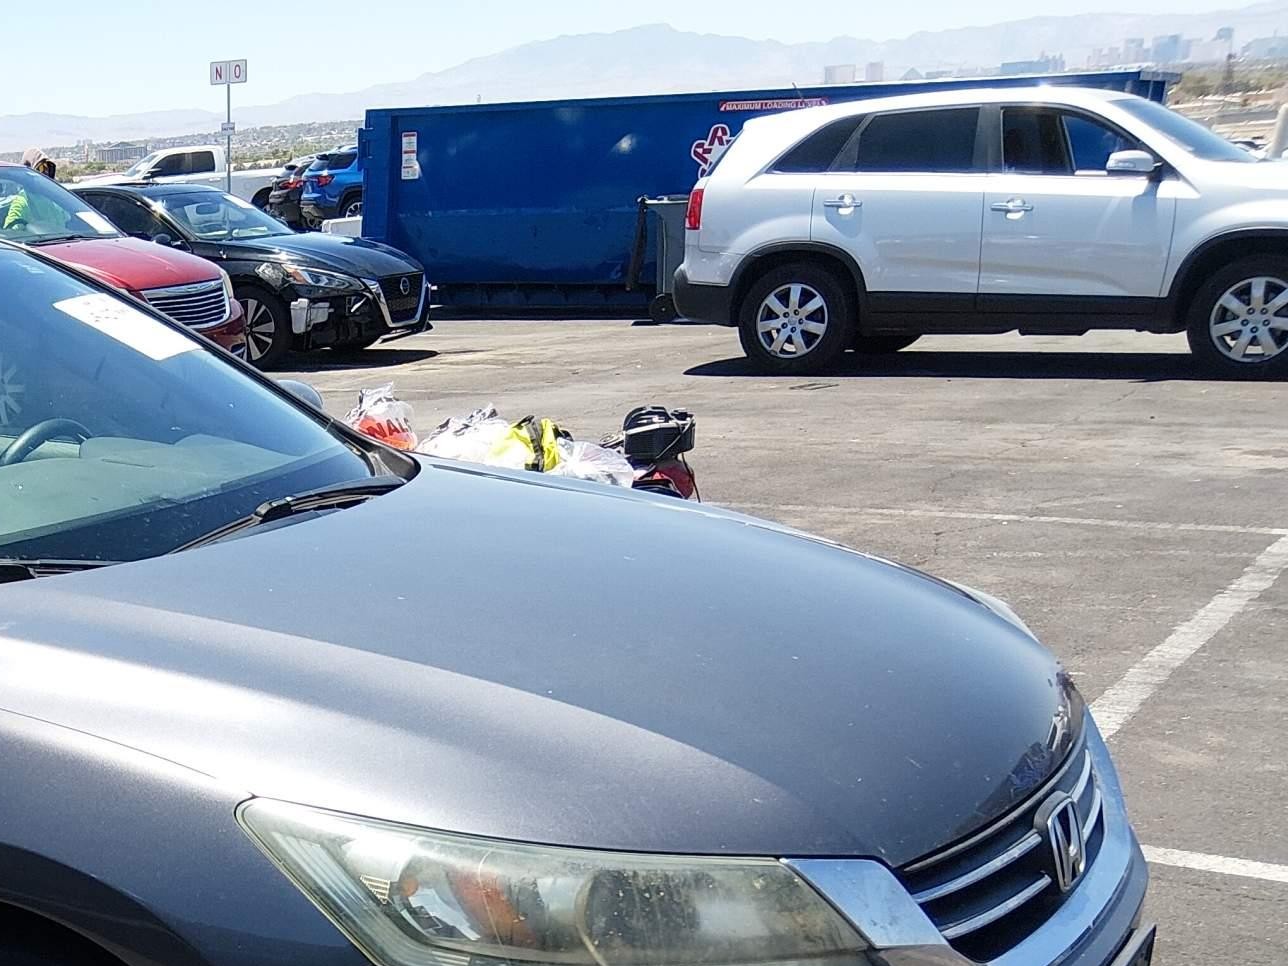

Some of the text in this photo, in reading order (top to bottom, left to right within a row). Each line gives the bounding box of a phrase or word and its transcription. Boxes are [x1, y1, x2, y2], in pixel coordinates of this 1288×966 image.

[215, 66, 223, 81] N
[726, 102, 762, 111] MAXIMUM
[762, 101, 797, 109] LOADING
